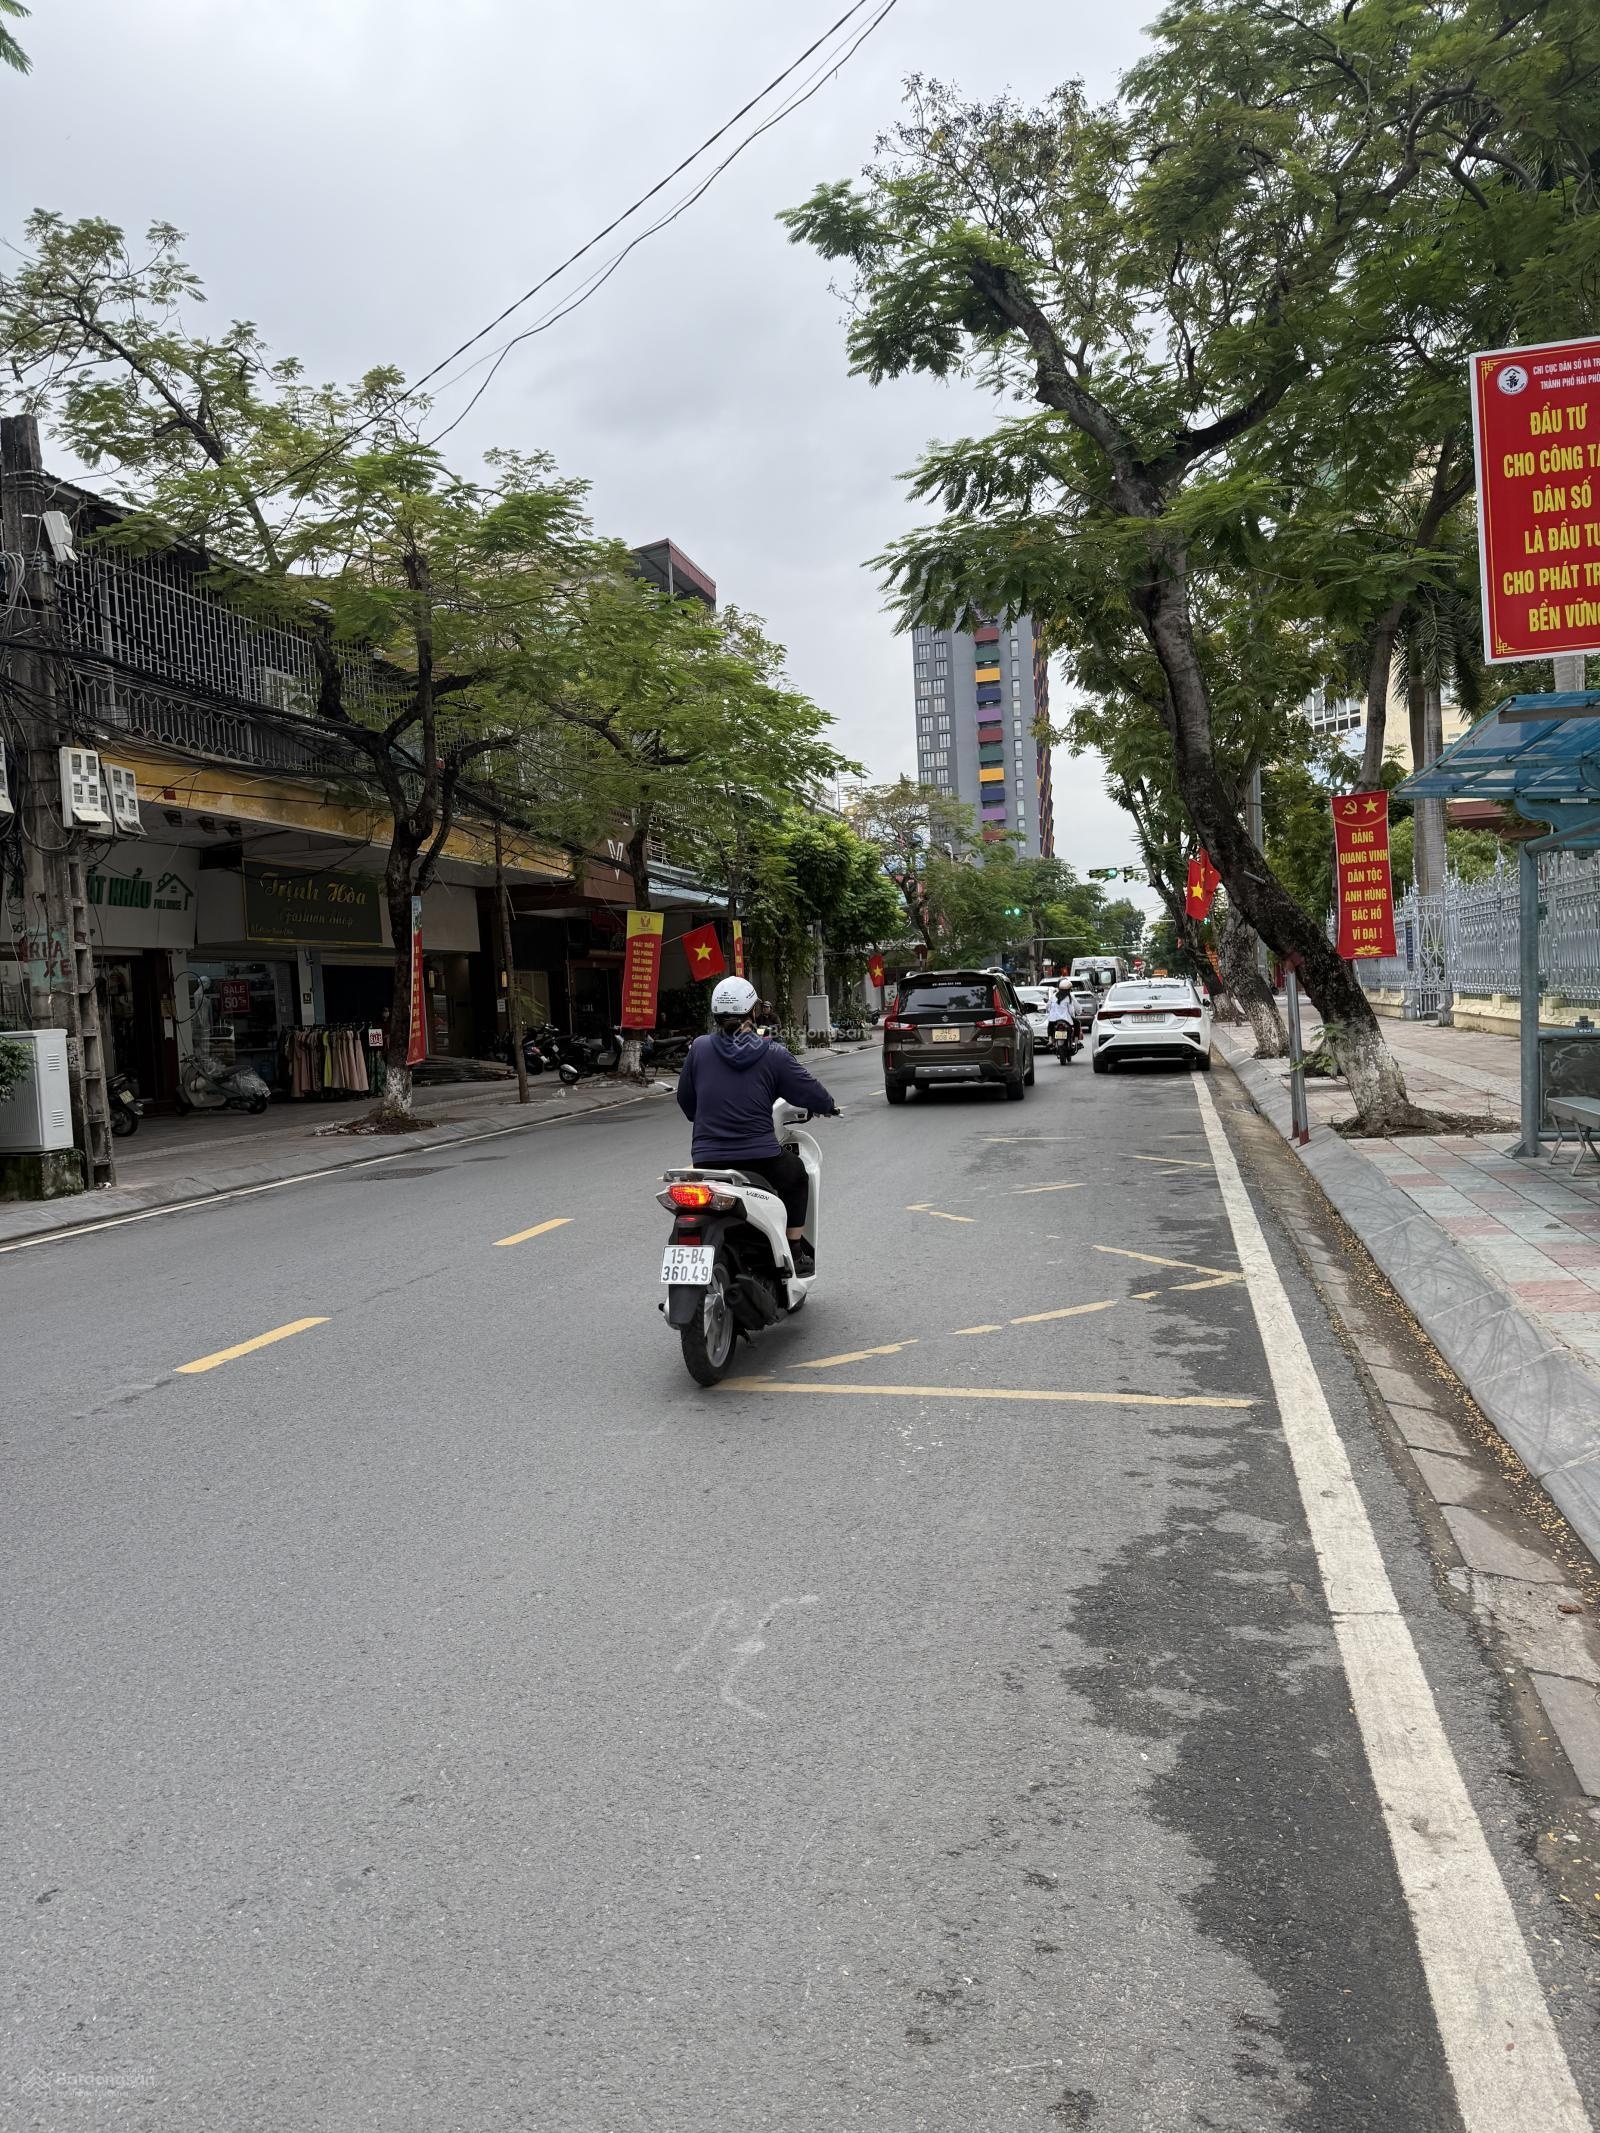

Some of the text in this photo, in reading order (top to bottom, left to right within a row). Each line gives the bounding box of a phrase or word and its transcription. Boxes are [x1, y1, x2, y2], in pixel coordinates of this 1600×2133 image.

[1533, 365, 1544, 375] CHI
[1545, 363, 1557, 375] CỤC
[1559, 360, 1572, 372] DÂN
[1574, 357, 1582, 370] SỐ
[1541, 378, 1561, 390] THÀNH
[1562, 374, 1575, 388] PHỐ
[1576, 372, 1587, 386] HẢI
[1530, 402, 1588, 435] ĐẦU TƯ
[1503, 451, 1535, 478] CHO
[1540, 443, 1583, 474] CÔNG
[1532, 475, 1592, 514] DÂN SỐ
[1524, 524, 1544, 554] LÀ
[1548, 518, 1580, 551] ĐẦU
[1503, 569, 1534, 595] CHO
[1539, 560, 1579, 591] PHÁT
[1528, 597, 1600, 632] BỀN VỮN
[1351, 828, 1374, 844] ĐẢNG
[1340, 849, 1388, 865] QUANG VINH
[1347, 867, 1382, 883] DÂN TỘC
[108, 867, 152, 908] KHẨU
[257, 871, 369, 905] Trịnh Hòa
[1345, 886, 1387, 902] ANH HÙNG
[1351, 906, 1368, 921] BÁC
[1352, 926, 1361, 940] VĨ
[1362, 927, 1377, 942] ĐẠI
[44, 959, 72, 978] XE
[223, 984, 246, 994] SALE
[746, 1190, 769, 1201] VISION
[671, 1248, 706, 1264] 15-B4
[662, 1265, 709, 1282] 360.49
